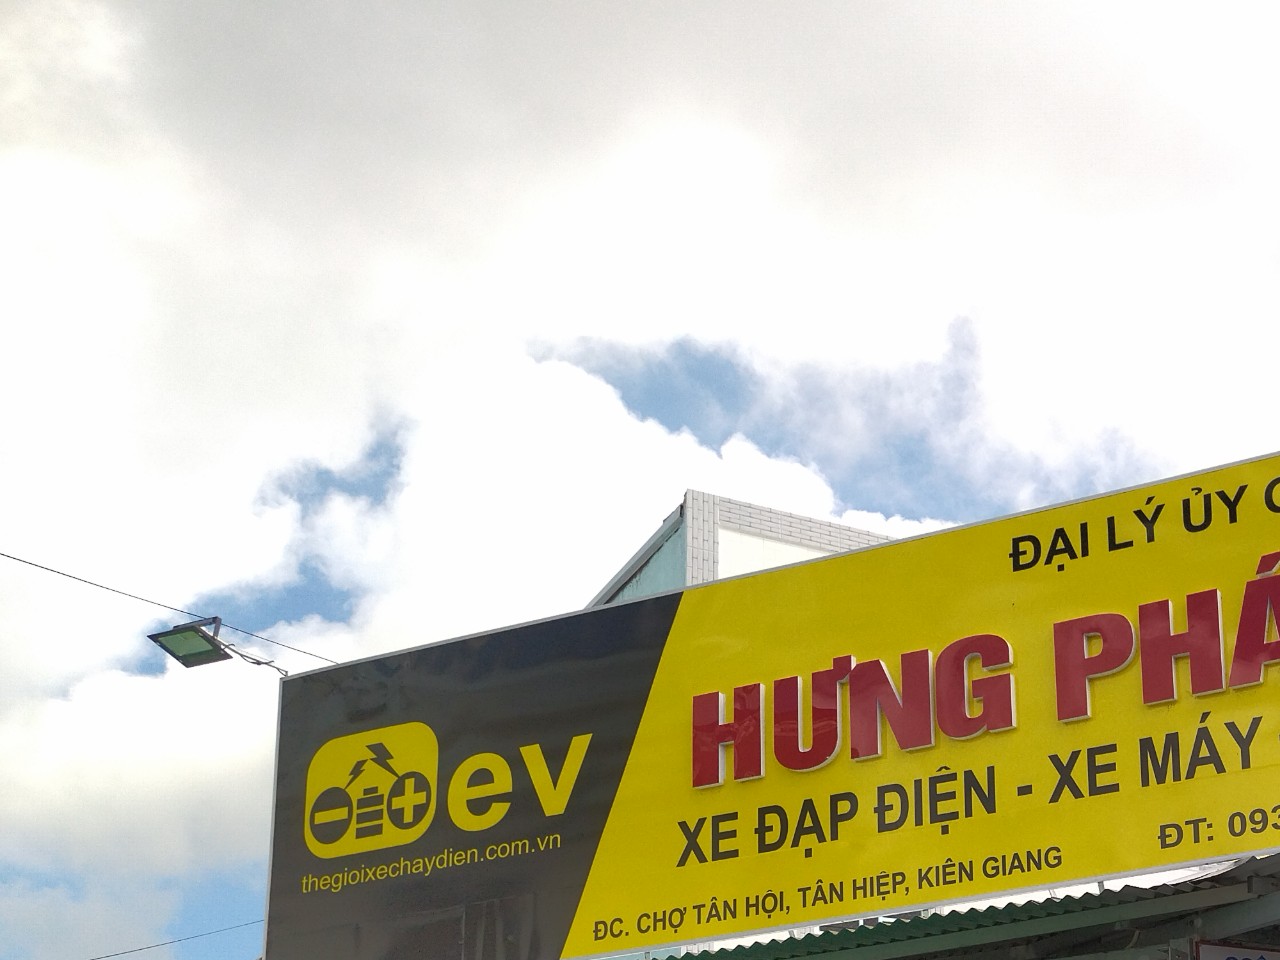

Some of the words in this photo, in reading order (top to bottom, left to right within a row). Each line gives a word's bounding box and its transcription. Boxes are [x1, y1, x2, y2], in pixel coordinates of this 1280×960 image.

[1009, 522, 1089, 572] ĐẠI
[1108, 495, 1165, 552] LÝ
[1182, 486, 1248, 535] ỦY
[692, 633, 1017, 789] HƯNG
[447, 733, 594, 832] ev
[676, 811, 740, 868] XE
[754, 791, 859, 859] ĐẠP
[874, 766, 997, 836] ĐIỆN
[1048, 744, 1120, 804] XE
[1140, 712, 1264, 787] MÁY
[302, 834, 561, 893] thegioixechaydien.com.vn
[1158, 817, 1214, 850] ĐT:
[593, 918, 631, 941] ĐC.
[637, 905, 688, 934] CHỢ
[693, 896, 738, 924] TÂN
[745, 889, 791, 919] HỘI,
[797, 879, 845, 909] TÂN
[852, 871, 910, 901] HIỆP,
[918, 857, 974, 890] KIÊN
[981, 846, 1063, 878] GIANG
